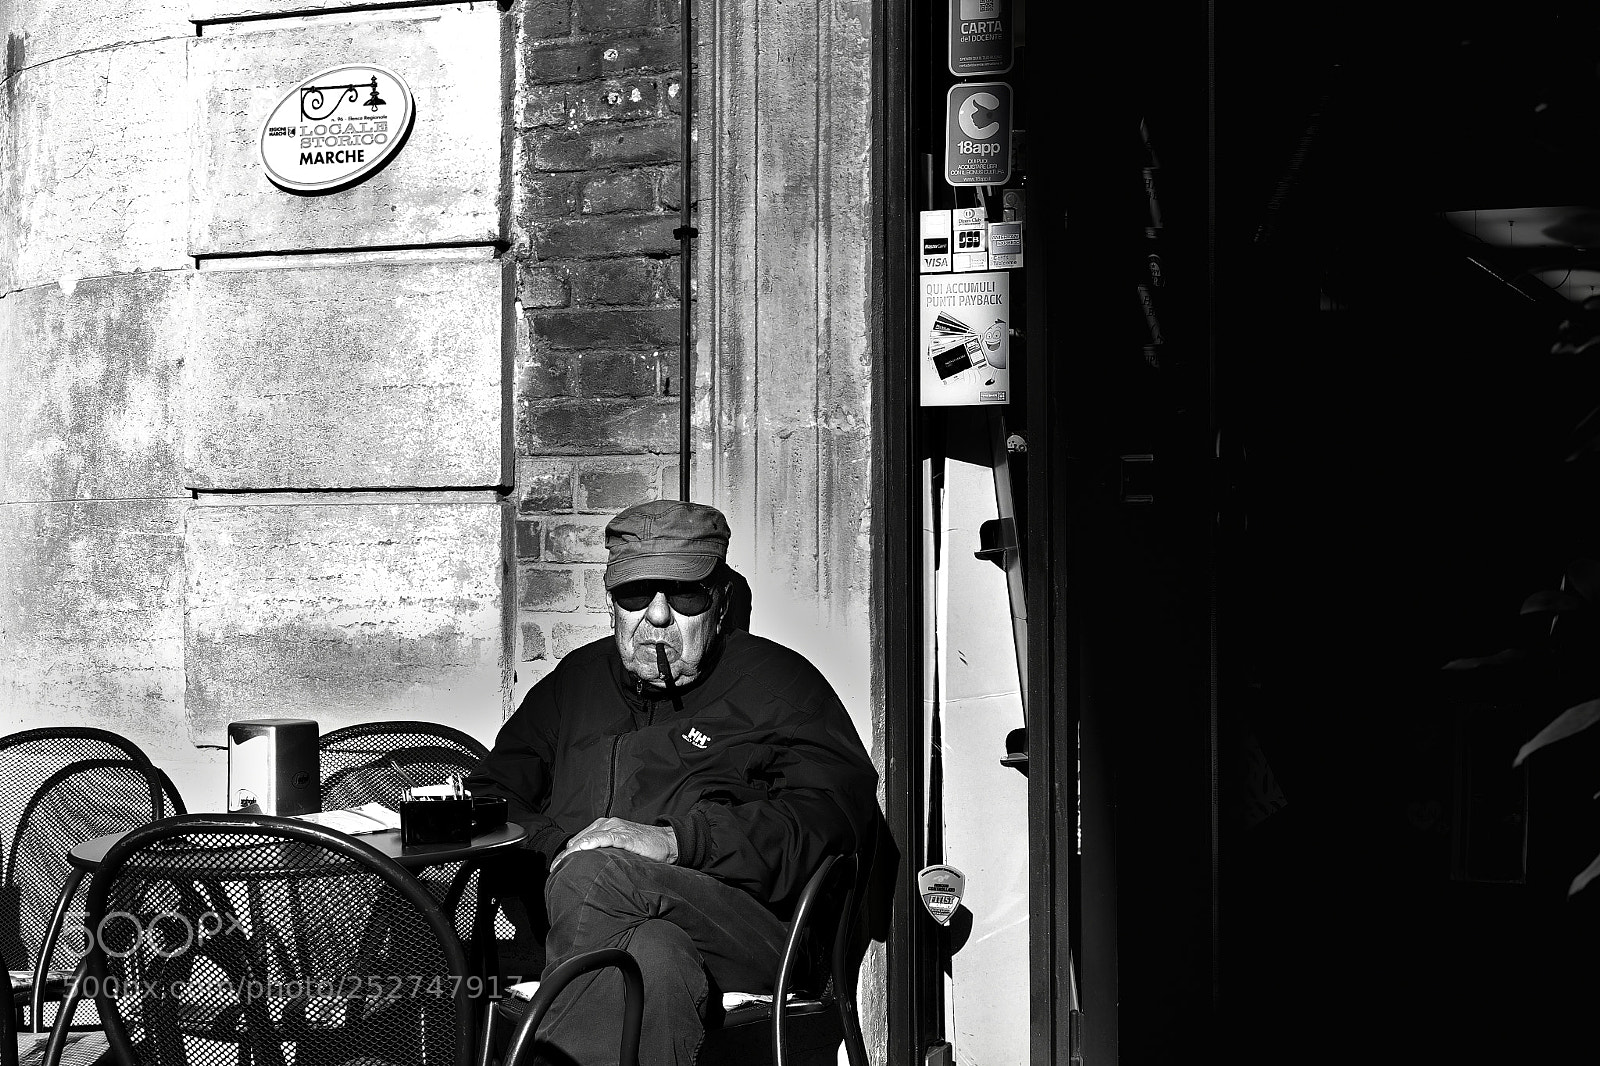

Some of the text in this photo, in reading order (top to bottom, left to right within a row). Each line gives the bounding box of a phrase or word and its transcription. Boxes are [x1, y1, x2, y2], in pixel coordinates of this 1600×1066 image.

[961, 21, 1002, 34] CARTA
[960, 34, 1003, 43] del DOCENTE
[300, 121, 388, 136] LOCALE
[300, 133, 388, 149] STORICO
[957, 141, 1000, 156] 18app
[300, 150, 364, 165] MARCHE
[925, 258, 948, 267] VISA
[926, 282, 995, 295] QUI ACCUMULI
[926, 294, 1003, 307] PUNTI PAYBACK
